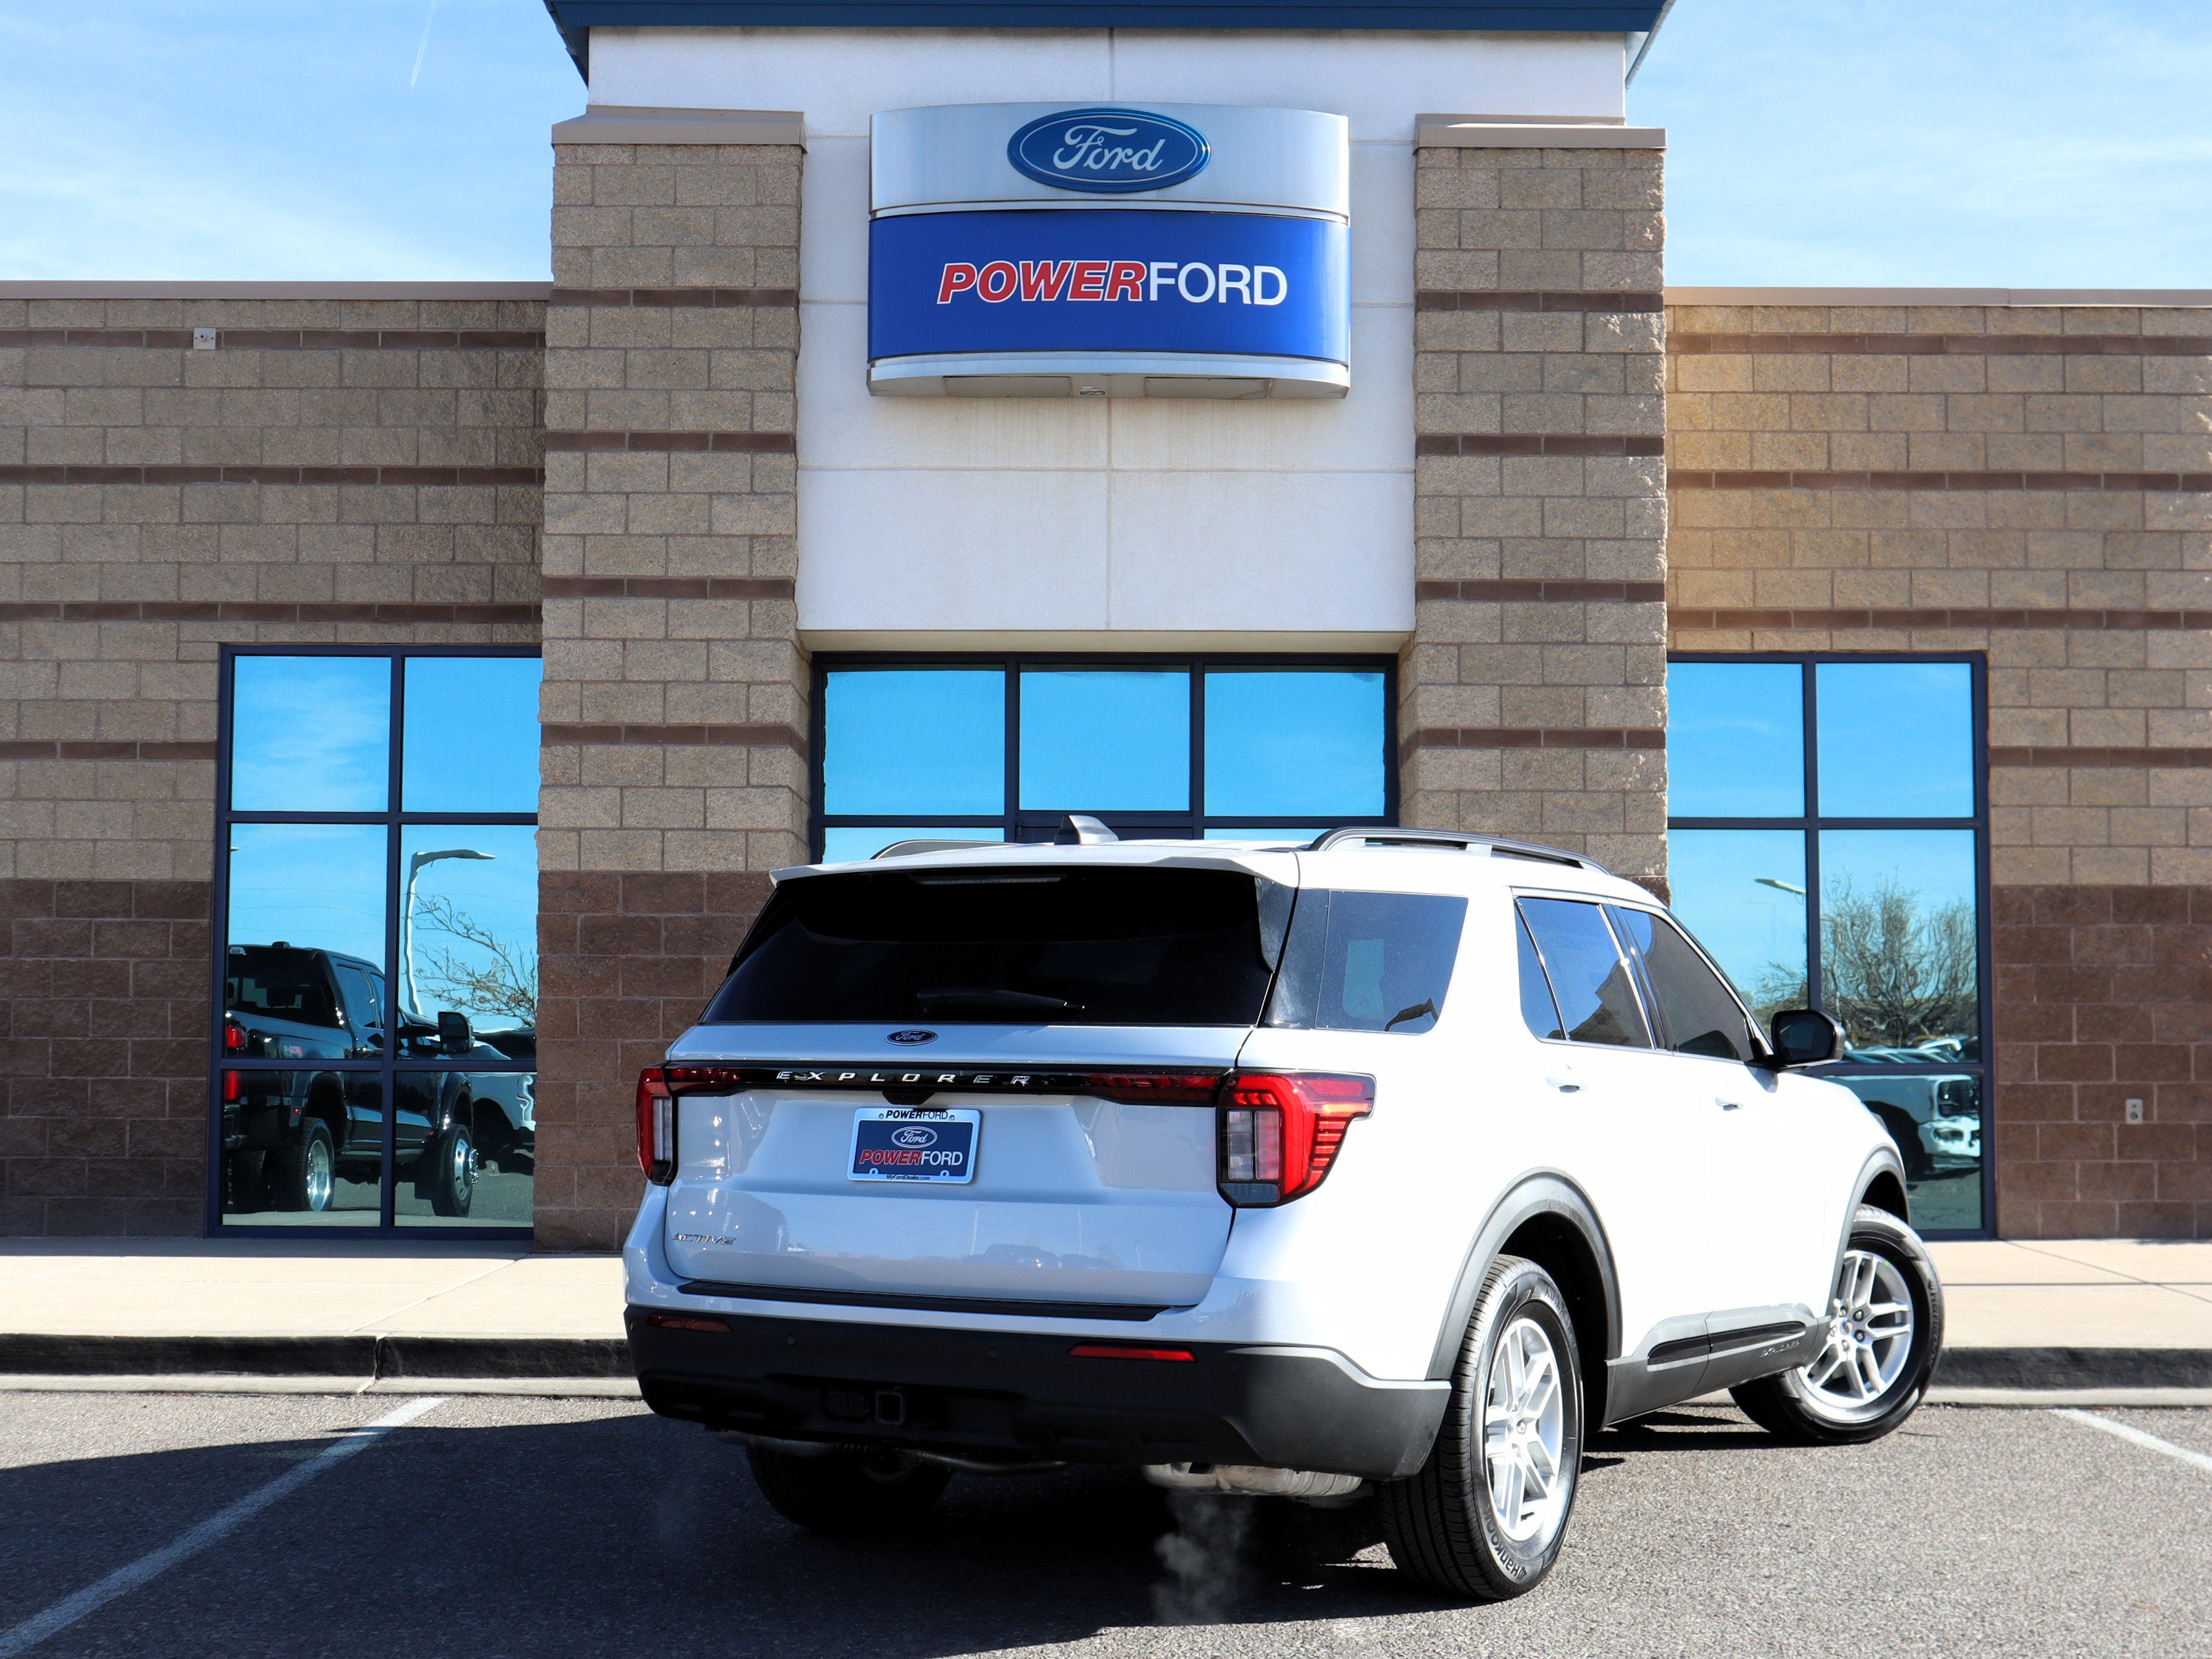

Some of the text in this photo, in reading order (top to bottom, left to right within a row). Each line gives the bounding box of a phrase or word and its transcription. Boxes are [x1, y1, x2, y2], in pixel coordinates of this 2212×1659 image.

[1053, 125, 1165, 171] Ford
[937, 260, 1288, 305] POWERFORD
[896, 1031, 926, 1041] Ford
[777, 1071, 1031, 1085] EXPLORER
[900, 1130, 929, 1143] Ford
[672, 1233, 736, 1245] ACTIVE
